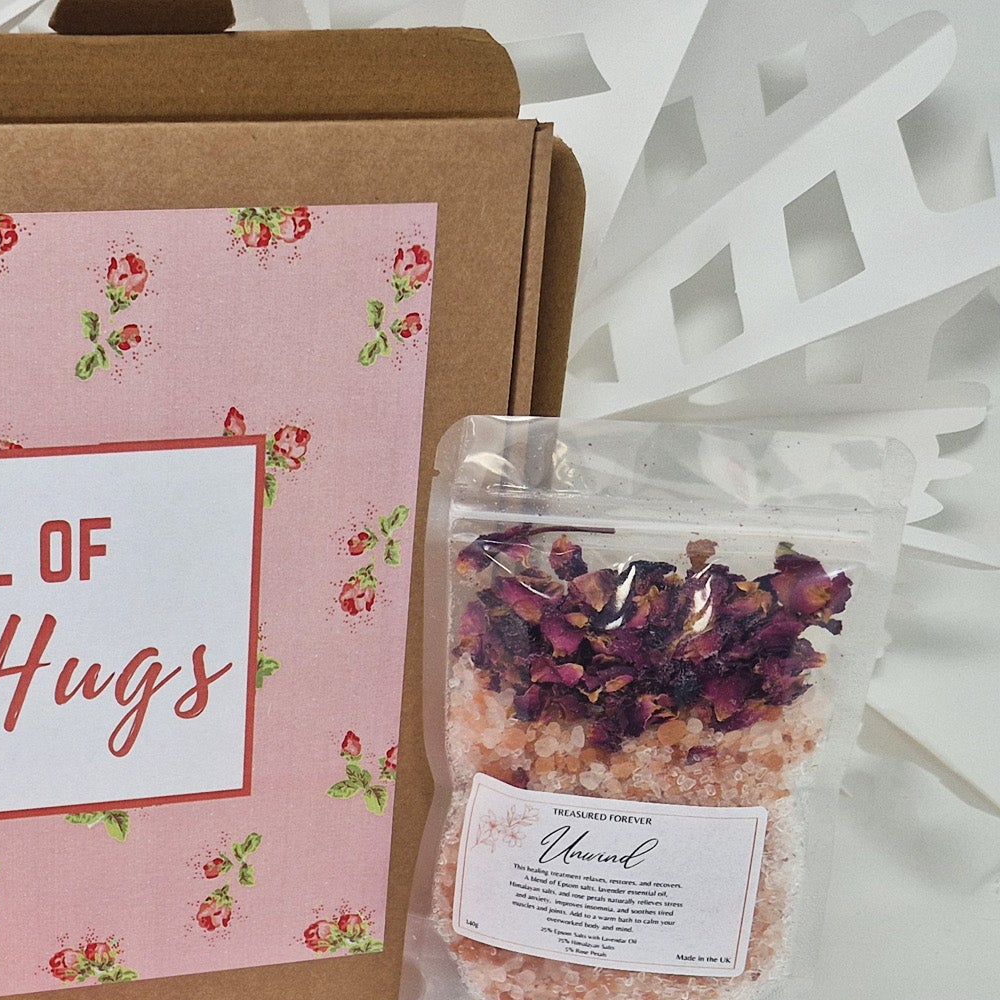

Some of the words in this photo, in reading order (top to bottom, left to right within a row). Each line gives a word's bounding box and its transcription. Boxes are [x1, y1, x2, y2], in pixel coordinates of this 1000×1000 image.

[38, 517, 111, 584] OF
[554, 808, 607, 821] TREASURED
[609, 814, 652, 825] FOREVER
[539, 825, 659, 869] Unwind
[514, 863, 525, 871] This
[527, 866, 548, 876] healing
[551, 871, 581, 880] treatment
[510, 881, 540, 892] Himalayan
[608, 897, 635, 905] naturally
[531, 876, 548, 884] blend
[558, 881, 579, 889] Epsom
[598, 886, 625, 894] lavender
[512, 901, 535, 909] muscles
[555, 900, 582, 908] improves
[547, 917, 583, 927] overworked
